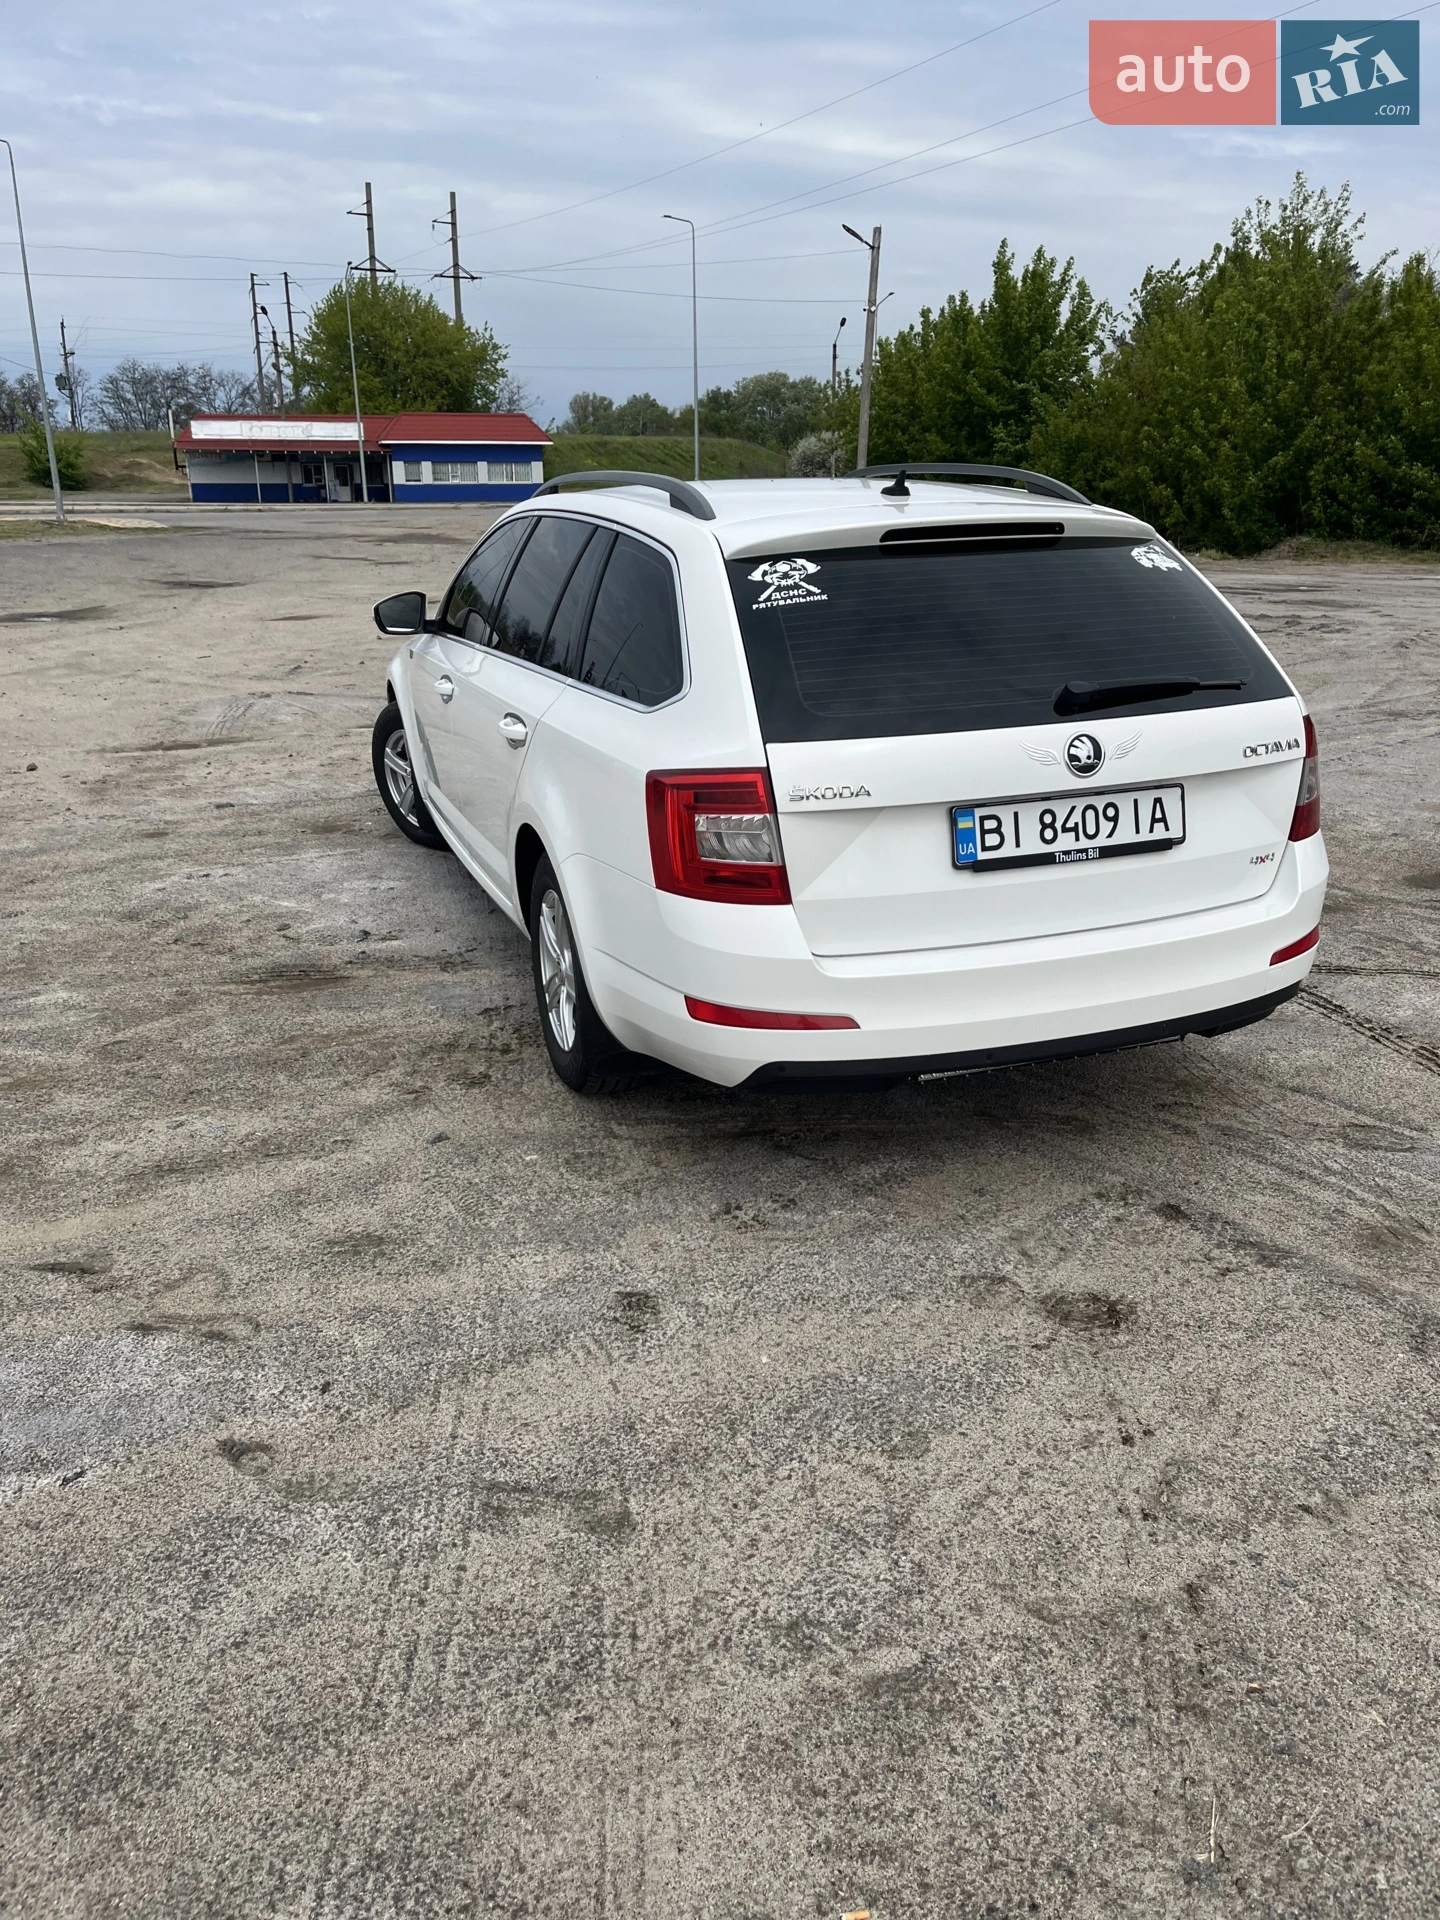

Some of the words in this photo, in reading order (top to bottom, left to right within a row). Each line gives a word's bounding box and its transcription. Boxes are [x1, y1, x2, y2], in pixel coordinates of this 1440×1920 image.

[752, 594, 828, 610] РЯТУВАЛЬНИК
[771, 588, 808, 601] ДСНС
[1243, 738, 1301, 758] OCTAVIA
[979, 811, 1021, 853] BI
[1039, 801, 1120, 845] 8409
[1133, 796, 1170, 834] IA
[959, 842, 975, 855] UA
[1054, 851, 1087, 863] Thulins
[1087, 848, 1099, 859] Bil
